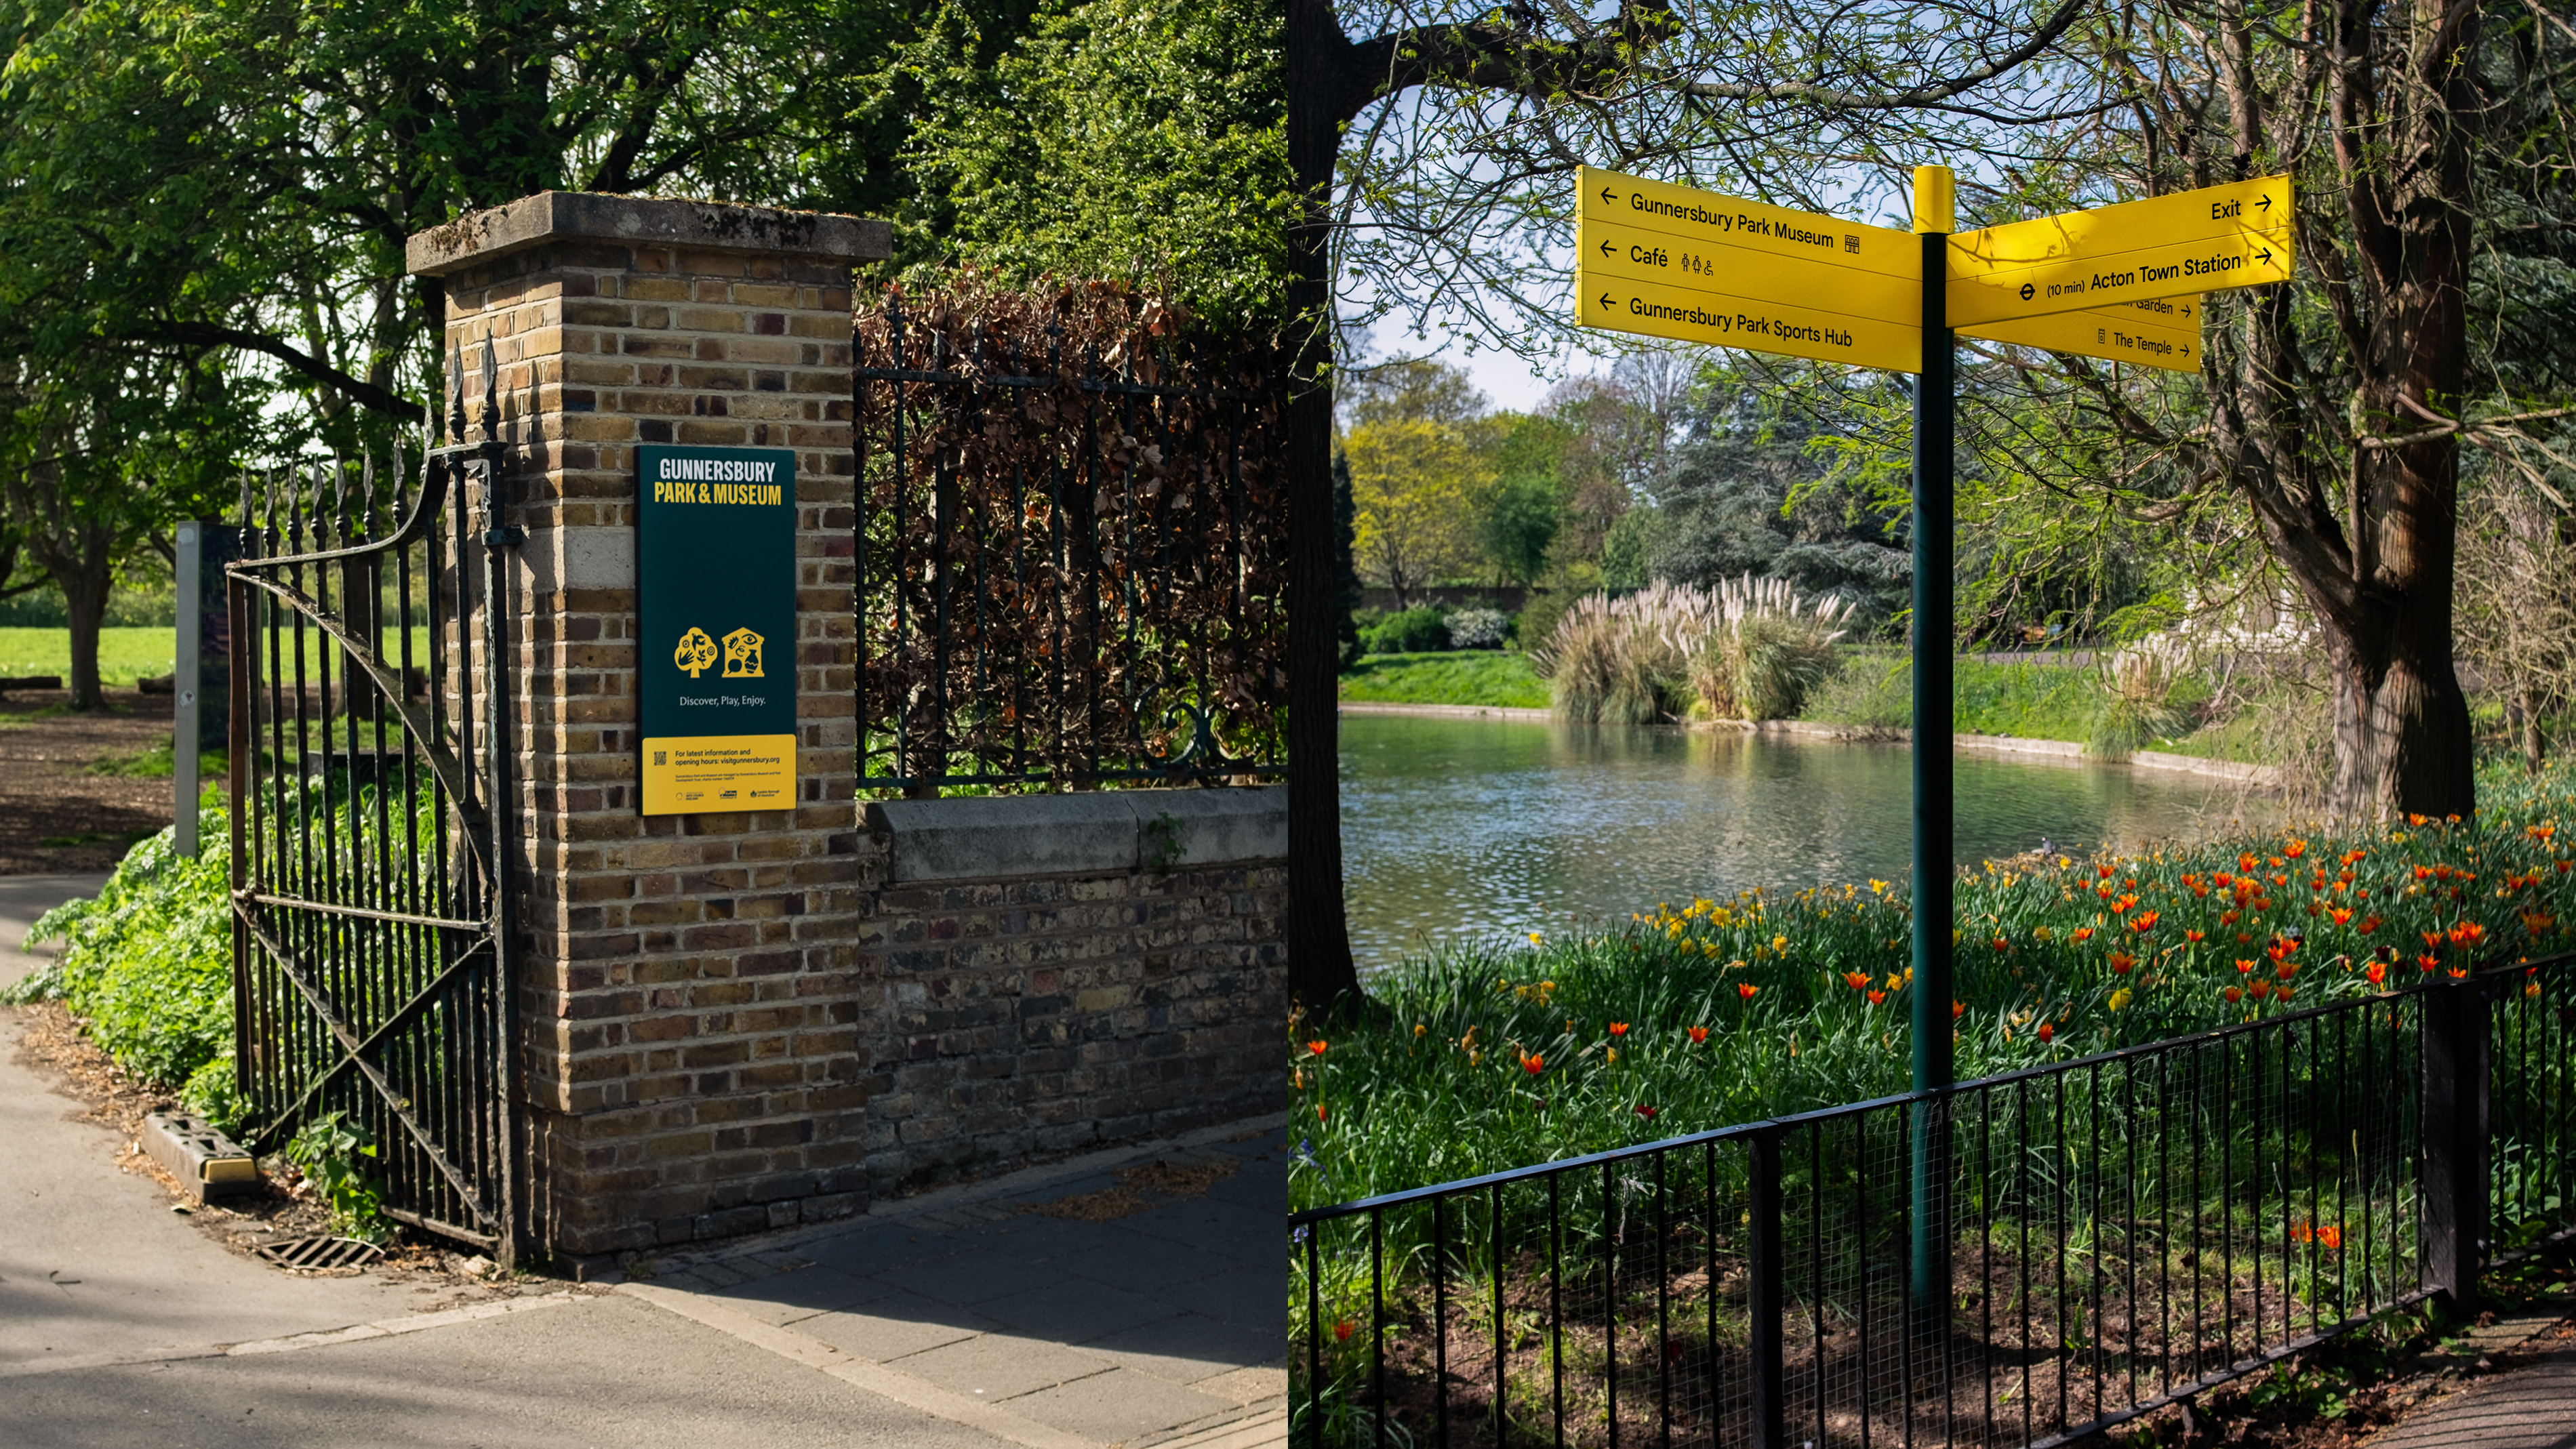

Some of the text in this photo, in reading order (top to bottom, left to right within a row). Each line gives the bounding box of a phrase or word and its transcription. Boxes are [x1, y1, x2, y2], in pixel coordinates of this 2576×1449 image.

[1631, 193, 1834, 248] Gunnersbury Park Museum
[2212, 199, 2241, 220] Exit
[1630, 245, 1668, 268] Café
[2047, 253, 2241, 299] (10 min) Acton Town Station
[2136, 299, 2173, 315] Garden
[1630, 297, 1853, 347] Gunnersbury Park Sports Hub
[2114, 331, 2172, 356] The Temple
[660, 457, 776, 483] GUNNERSBURY
[654, 481, 782, 506] PARK & MUSEUM
[679, 695, 766, 708] Discover, Play, Enjoy.
[675, 750, 685, 758] For
[686, 749, 704, 757] latest
[704, 748, 738, 756] information
[675, 758, 700, 767] opening
[721, 756, 780, 766] visitgunnersbury.org
